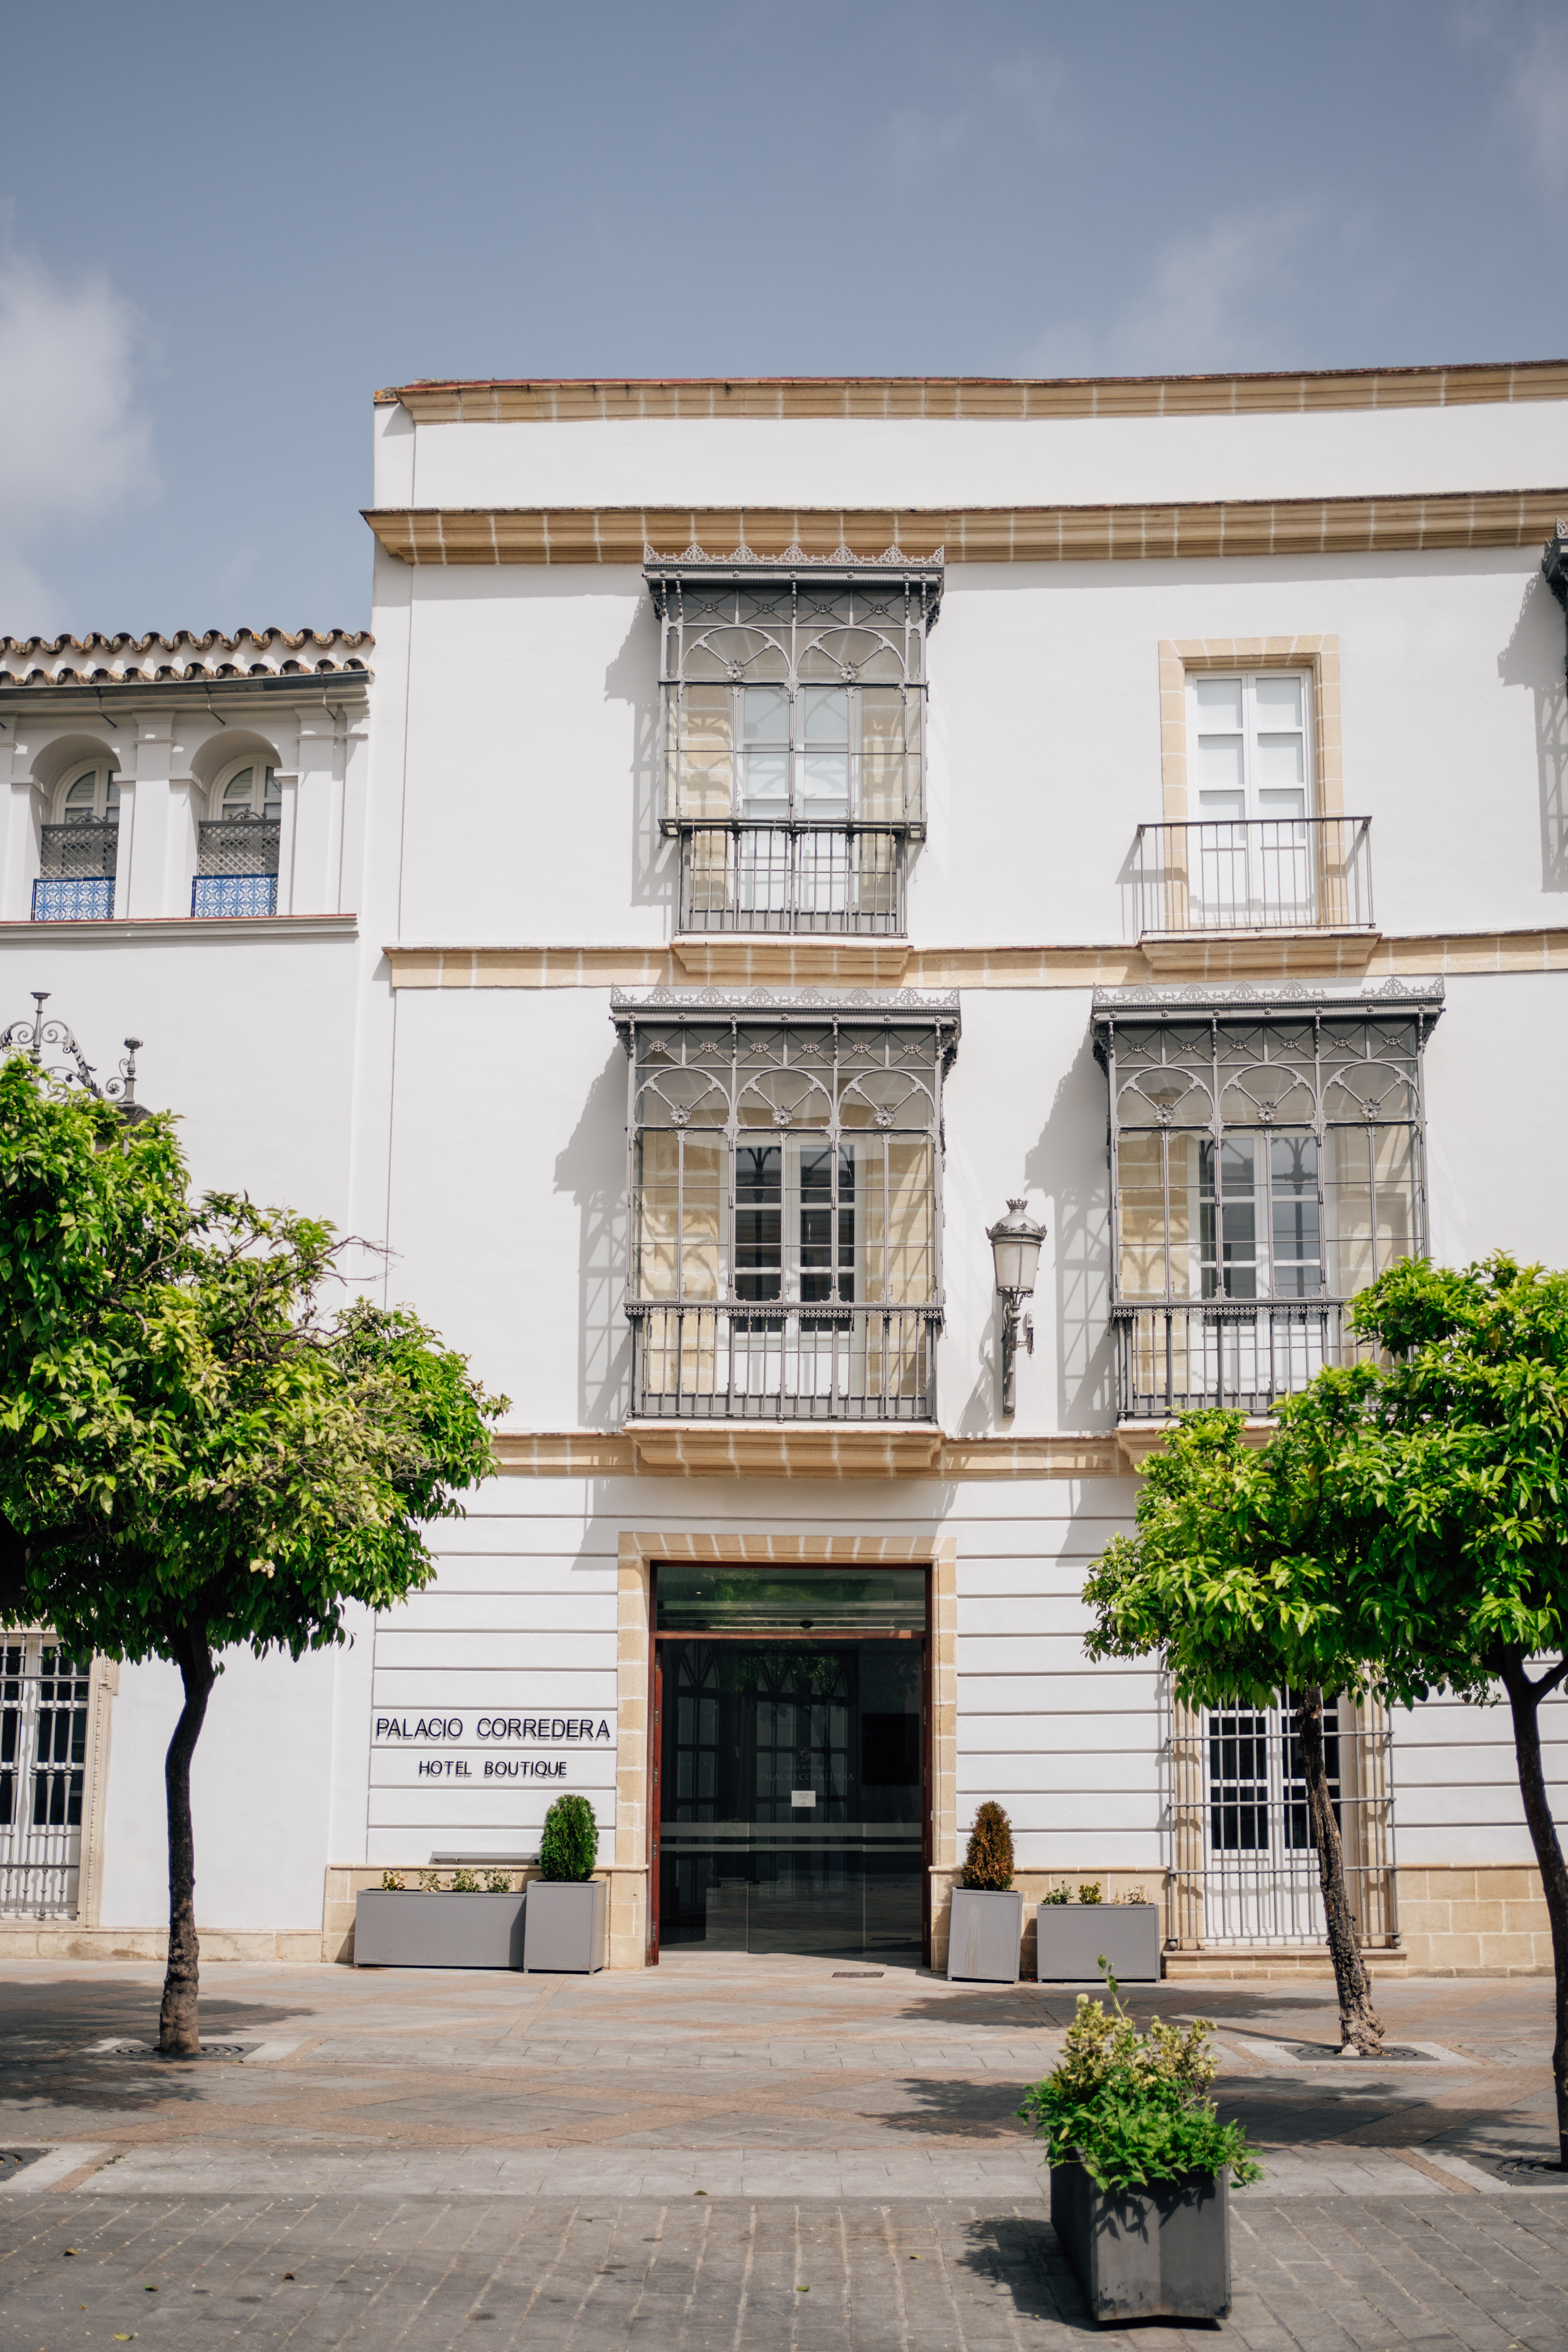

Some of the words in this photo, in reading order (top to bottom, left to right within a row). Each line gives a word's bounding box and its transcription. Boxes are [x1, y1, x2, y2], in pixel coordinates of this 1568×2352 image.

[377, 1718, 463, 1737] PALACIO
[477, 1718, 610, 1738] CORREDERA
[419, 1760, 472, 1774] HOTEL
[485, 1761, 567, 1776] BOUTIQUE
